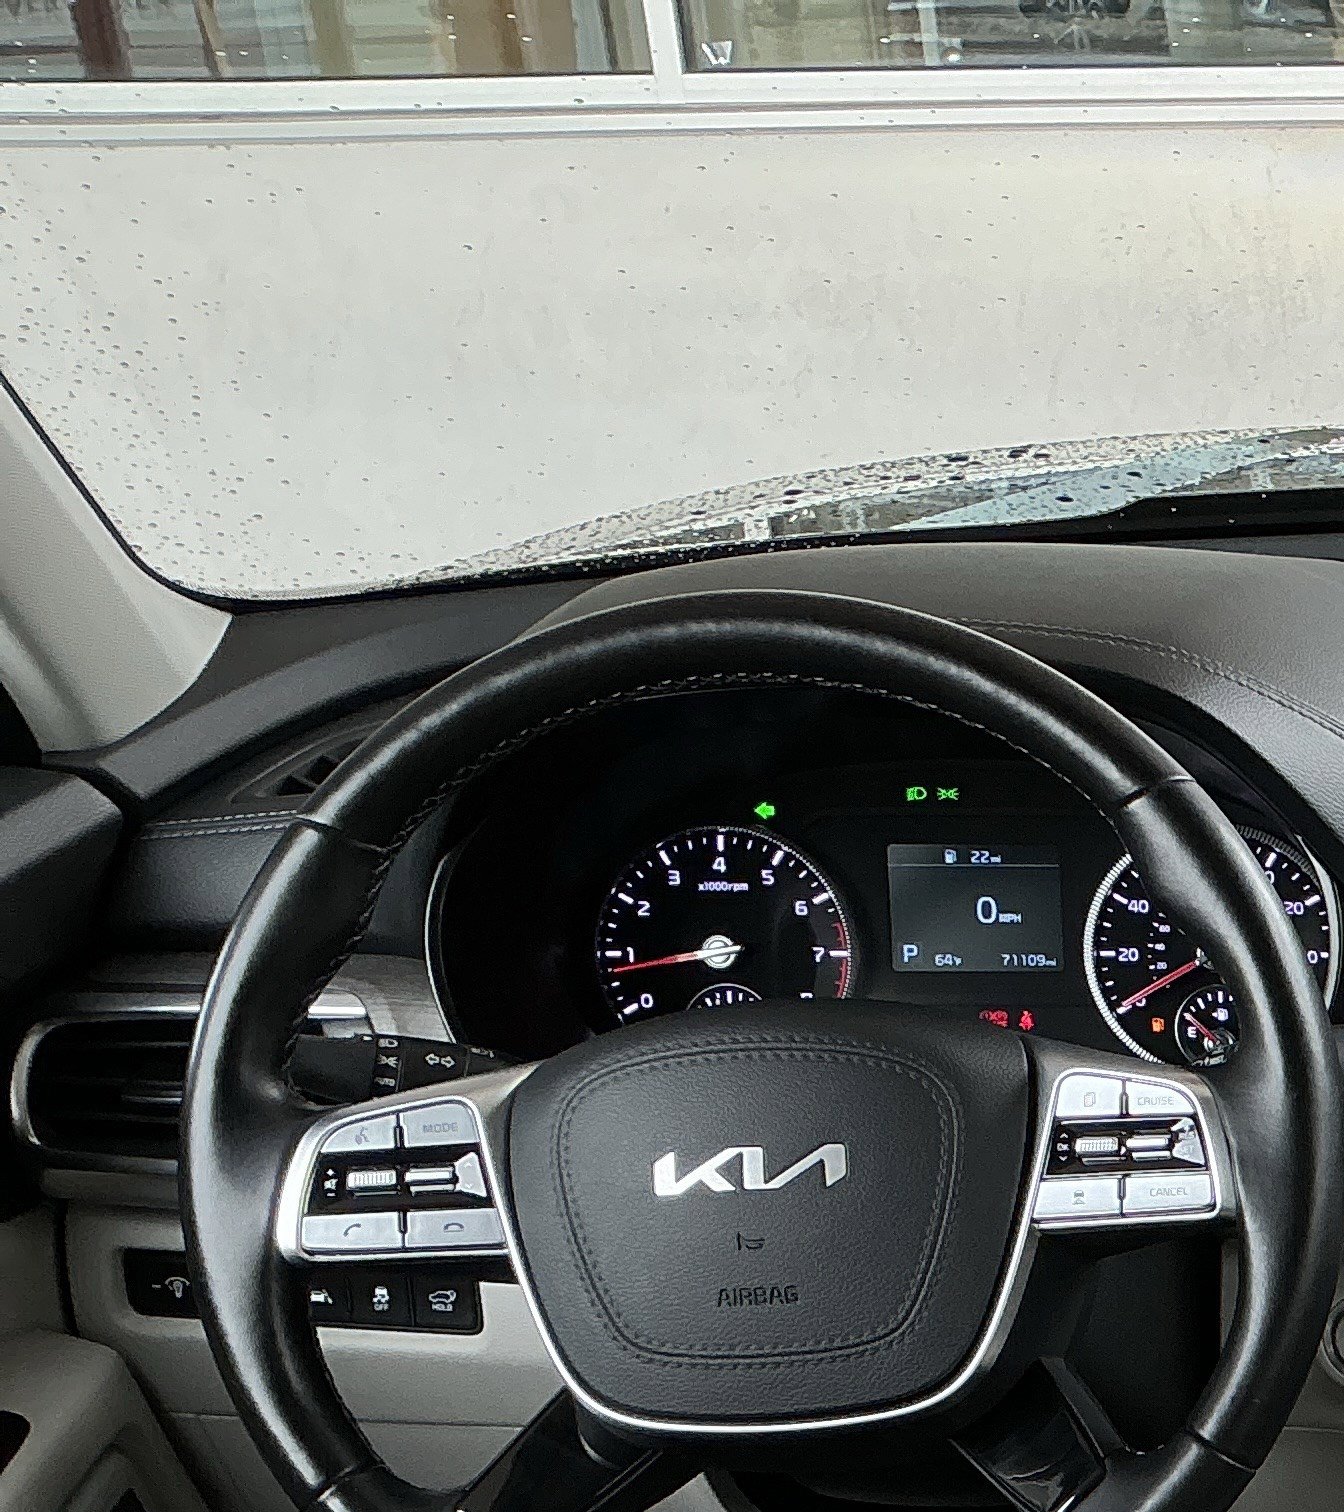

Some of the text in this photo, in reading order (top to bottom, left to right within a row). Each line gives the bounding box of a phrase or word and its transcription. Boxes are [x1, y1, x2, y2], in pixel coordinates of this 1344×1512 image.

[711, 856, 728, 873] 4
[667, 869, 681, 885] 3
[761, 869, 775, 885] 5
[637, 900, 651, 916] 2
[794, 900, 809, 916] 6
[975, 895, 998, 925] 0
[1127, 899, 1149, 914] 40
[626, 946, 635, 963] 1
[812, 946, 825, 963] 7
[902, 944, 919, 963] P
[1117, 947, 1139, 962] 20
[639, 993, 654, 1009] 0
[1187, 1026, 1197, 1038] E
[1136, 1095, 1175, 1107] CRUISE
[422, 1121, 459, 1135] MODE
[652, 1142, 848, 1197] KIA
[1149, 1186, 1189, 1198] CANCEL
[716, 1284, 800, 1308] AIRBAG
